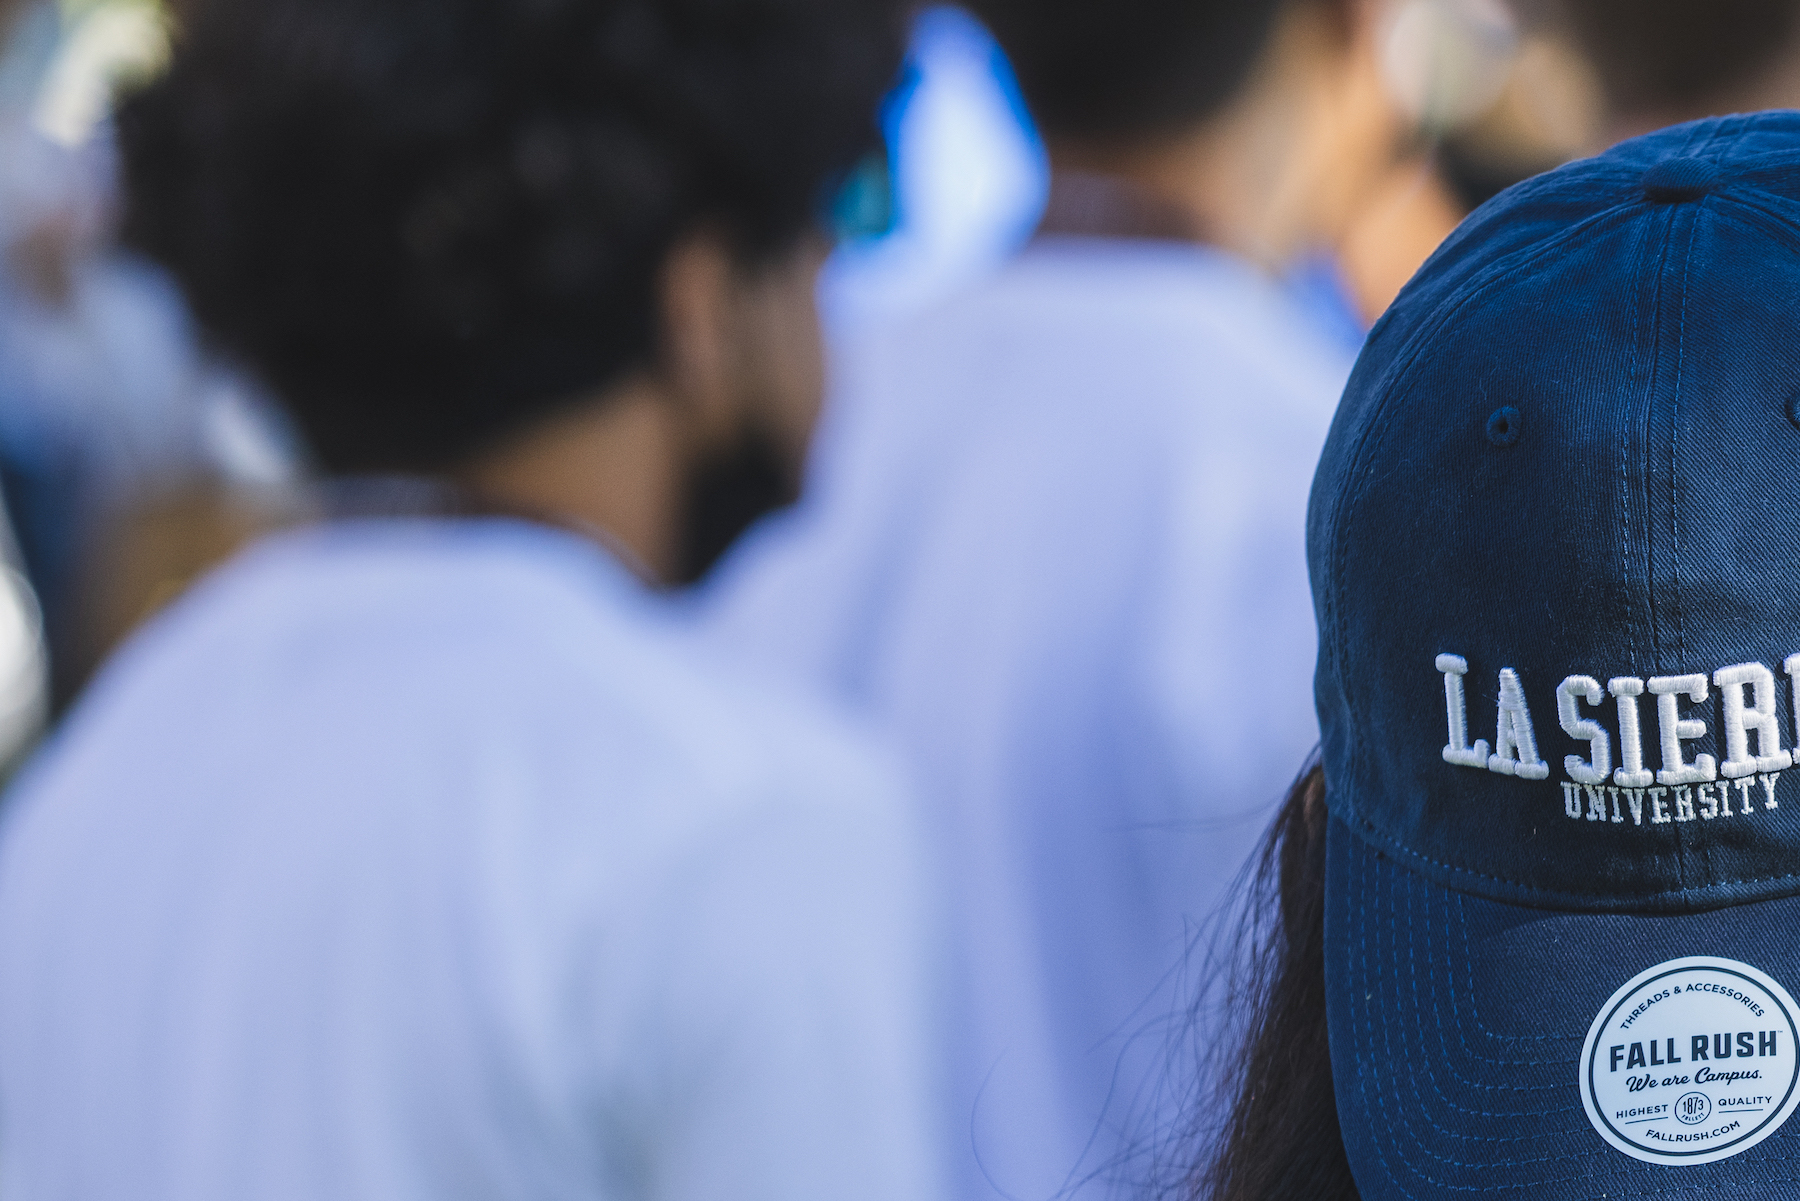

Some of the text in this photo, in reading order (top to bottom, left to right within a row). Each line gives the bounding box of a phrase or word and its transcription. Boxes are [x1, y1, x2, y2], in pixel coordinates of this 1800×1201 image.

[1435, 653, 1550, 780] LA
[1560, 772, 1782, 826] UNIVERSITY
[1620, 983, 1765, 1030] THREADS & ACCESSORIES
[1610, 1038, 1681, 1072] FALL
[1626, 1067, 1762, 1093] We are Campus.
[1616, 1096, 1772, 1119] HIGHEST QUALITY
[1683, 1097, 1704, 1114] 1873
[1646, 1121, 1740, 1142] FALLRUSH.COM
